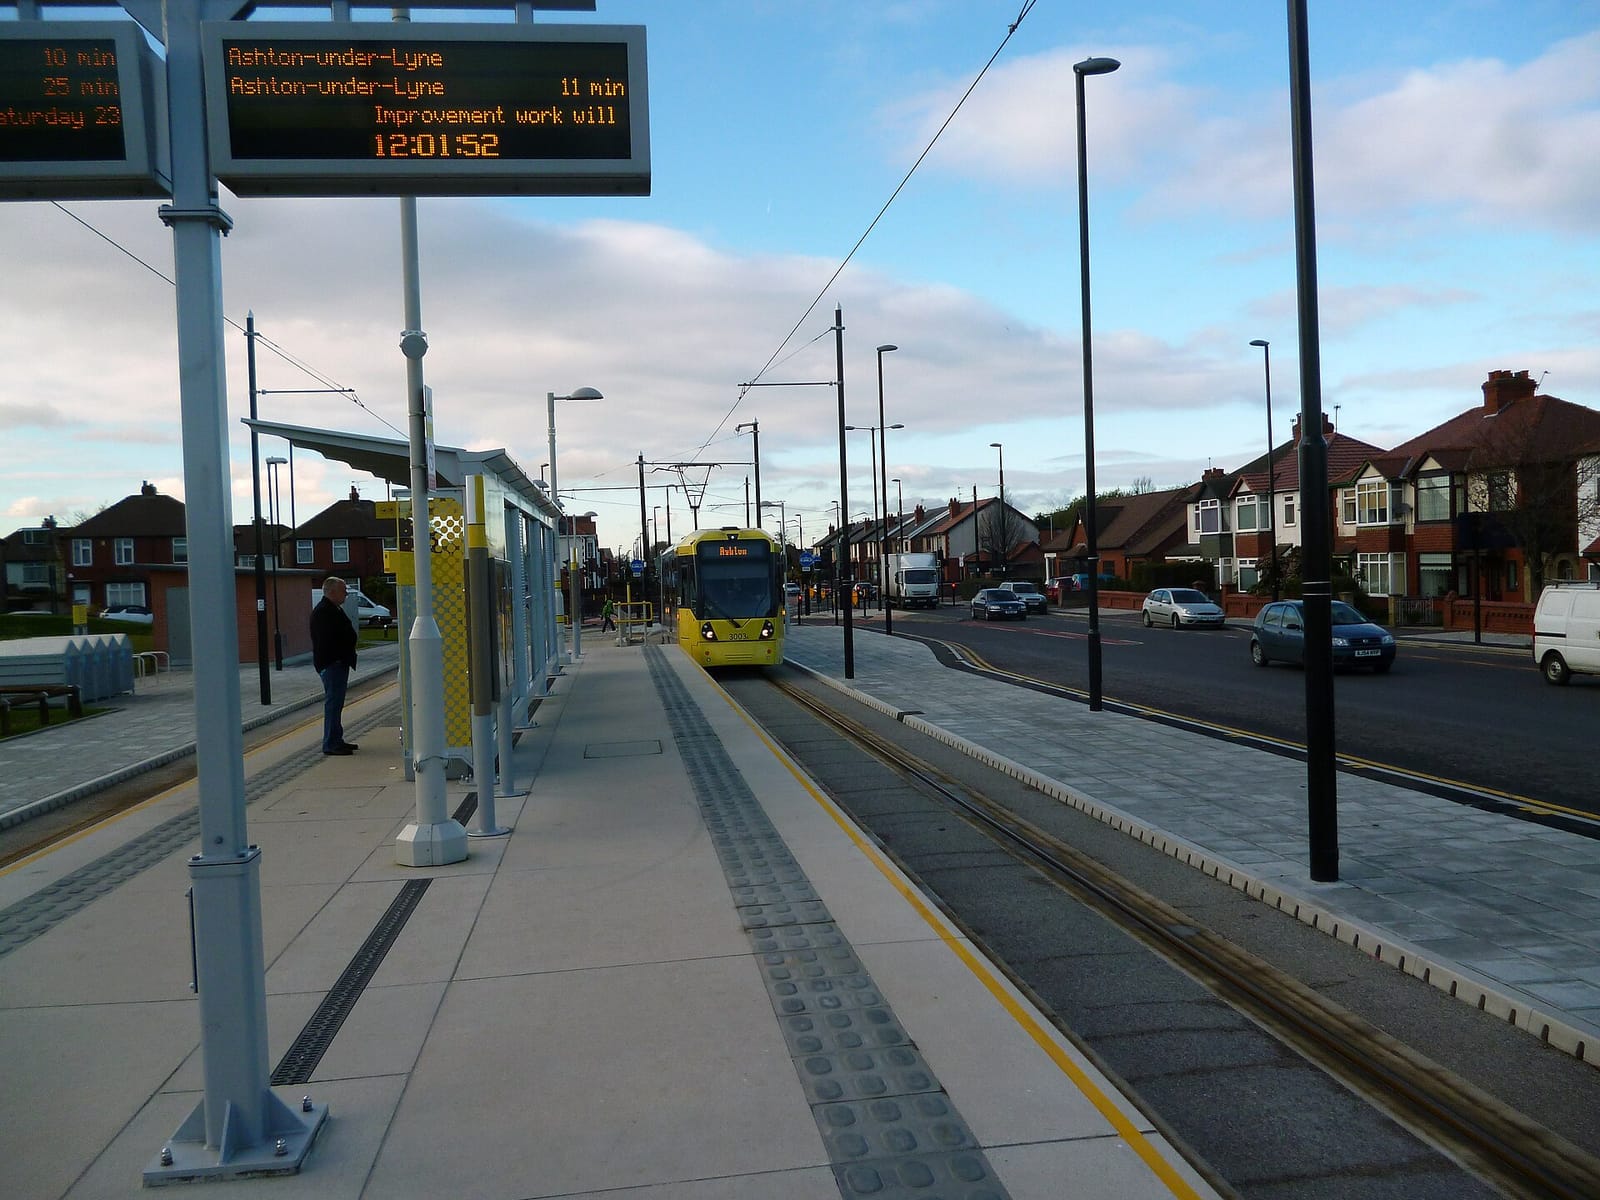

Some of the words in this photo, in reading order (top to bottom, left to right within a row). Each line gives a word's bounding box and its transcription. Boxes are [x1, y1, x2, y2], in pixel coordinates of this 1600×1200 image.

[44, 48, 67, 66] 10
[78, 48, 116, 66] min
[229, 48, 443, 70] Ashton-under-Lyne
[44, 78, 70, 95] 25
[81, 78, 118, 95] min
[231, 77, 445, 99] Ashton-under-Lyne
[562, 78, 580, 96] 11
[590, 78, 625, 96] min
[95, 106, 120, 124] 23
[375, 105, 505, 127] Improvement
[516, 106, 563, 124] work
[573, 106, 615, 124] will
[375, 134, 499, 156] 12:01:52
